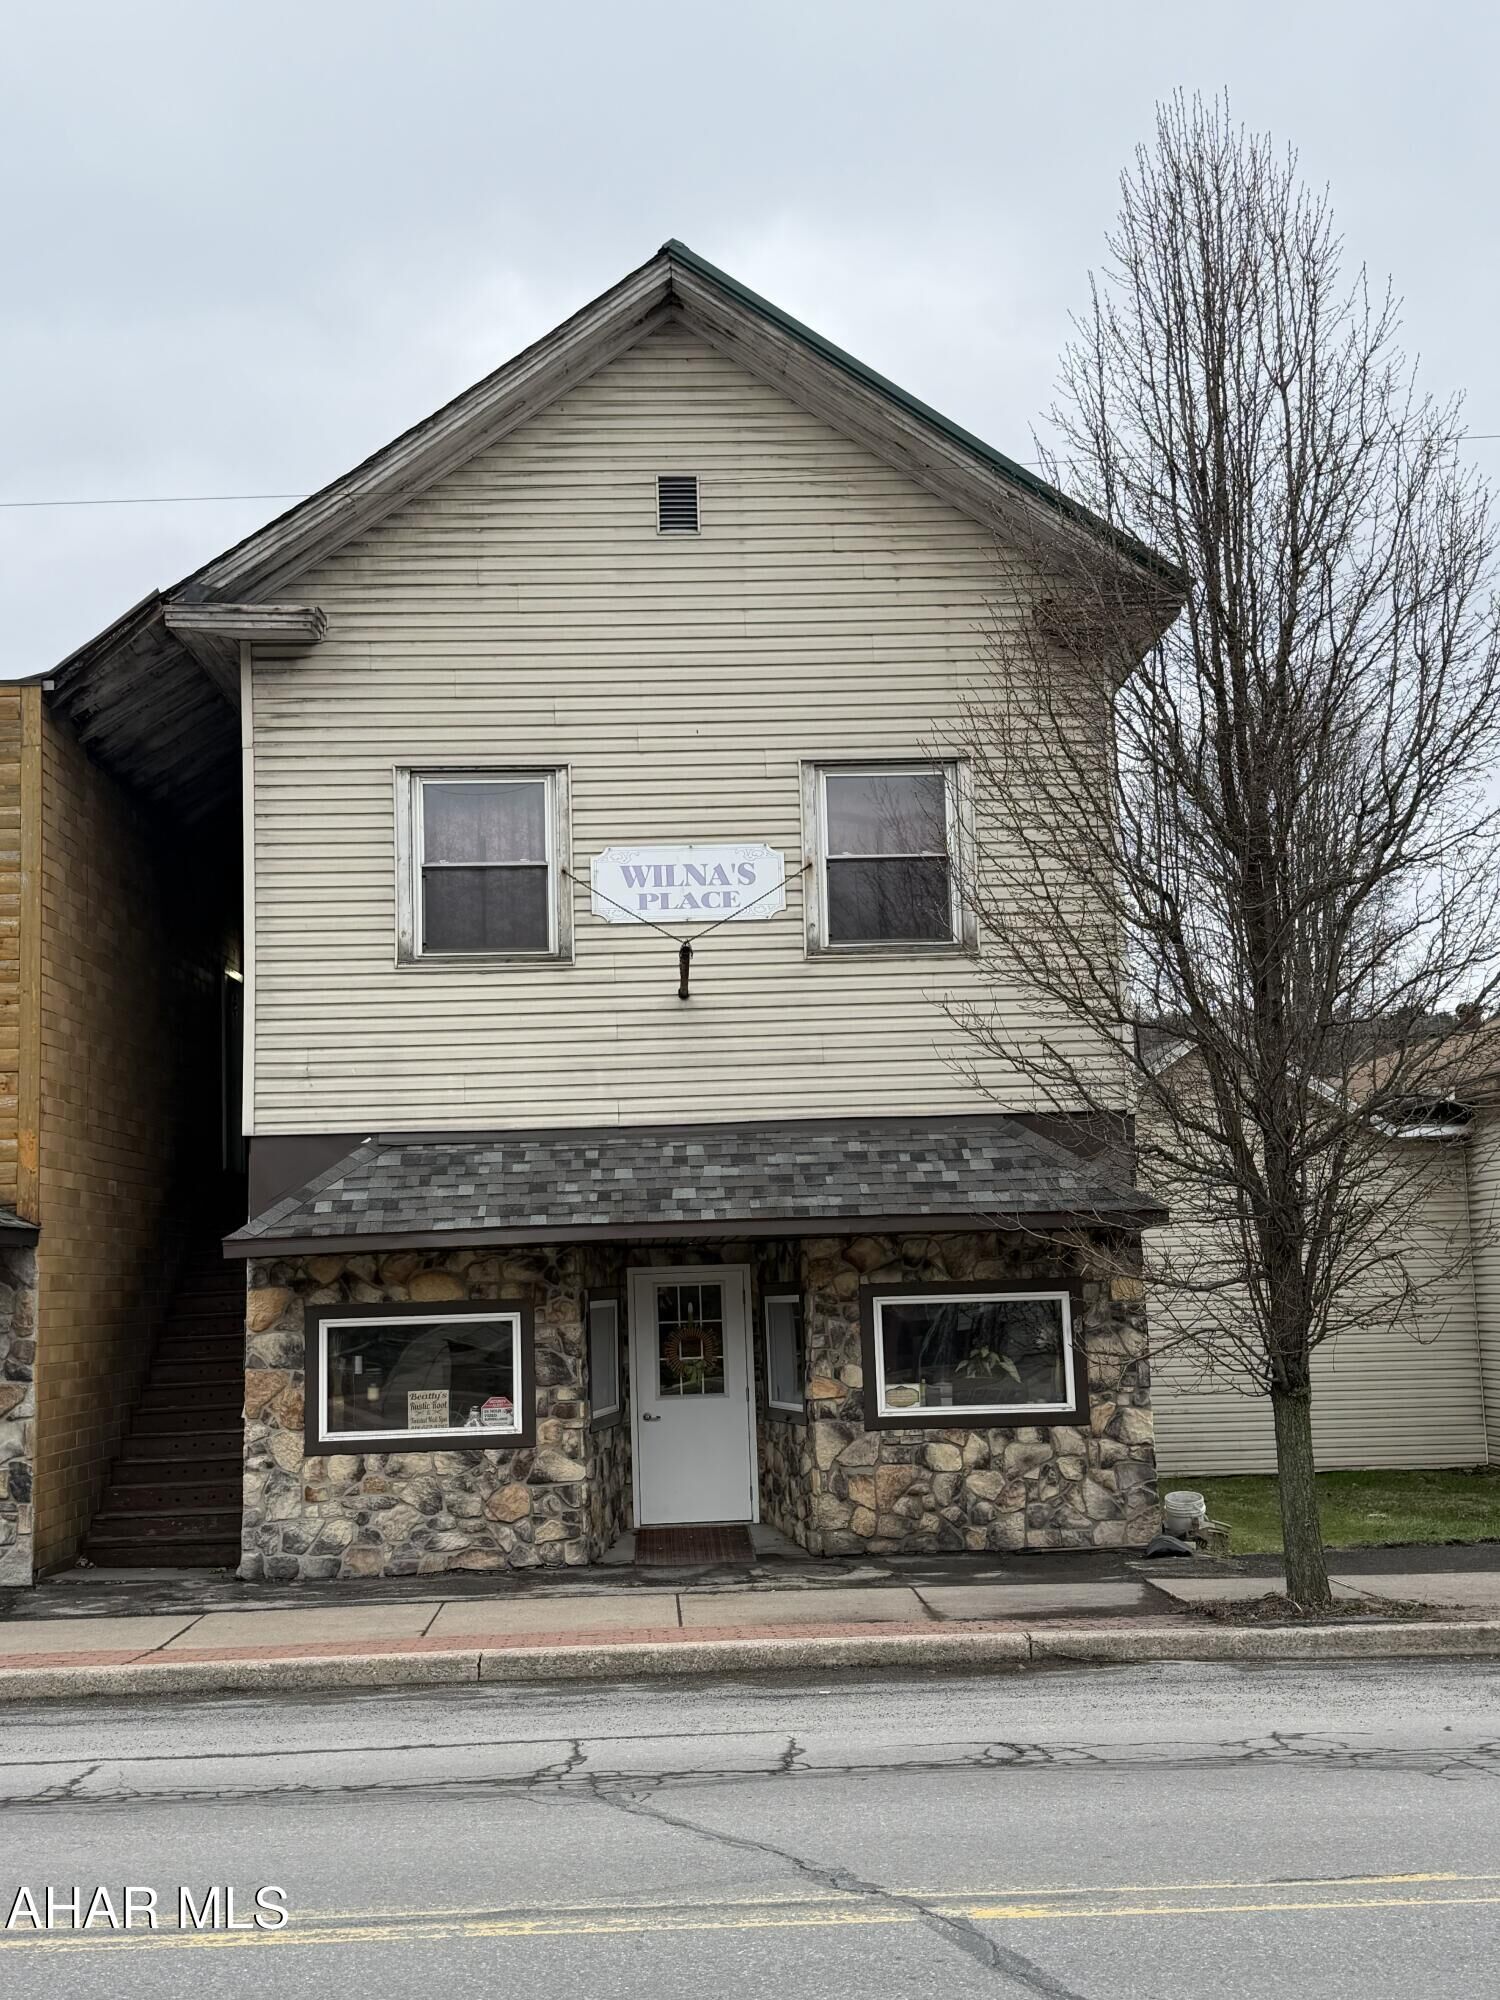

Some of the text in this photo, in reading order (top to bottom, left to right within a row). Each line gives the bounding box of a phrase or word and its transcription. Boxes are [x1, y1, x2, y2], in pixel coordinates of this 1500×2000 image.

[619, 862, 756, 888] WILNA'S
[636, 890, 741, 911] PLACE
[409, 1391, 448, 1401] Beatty's
